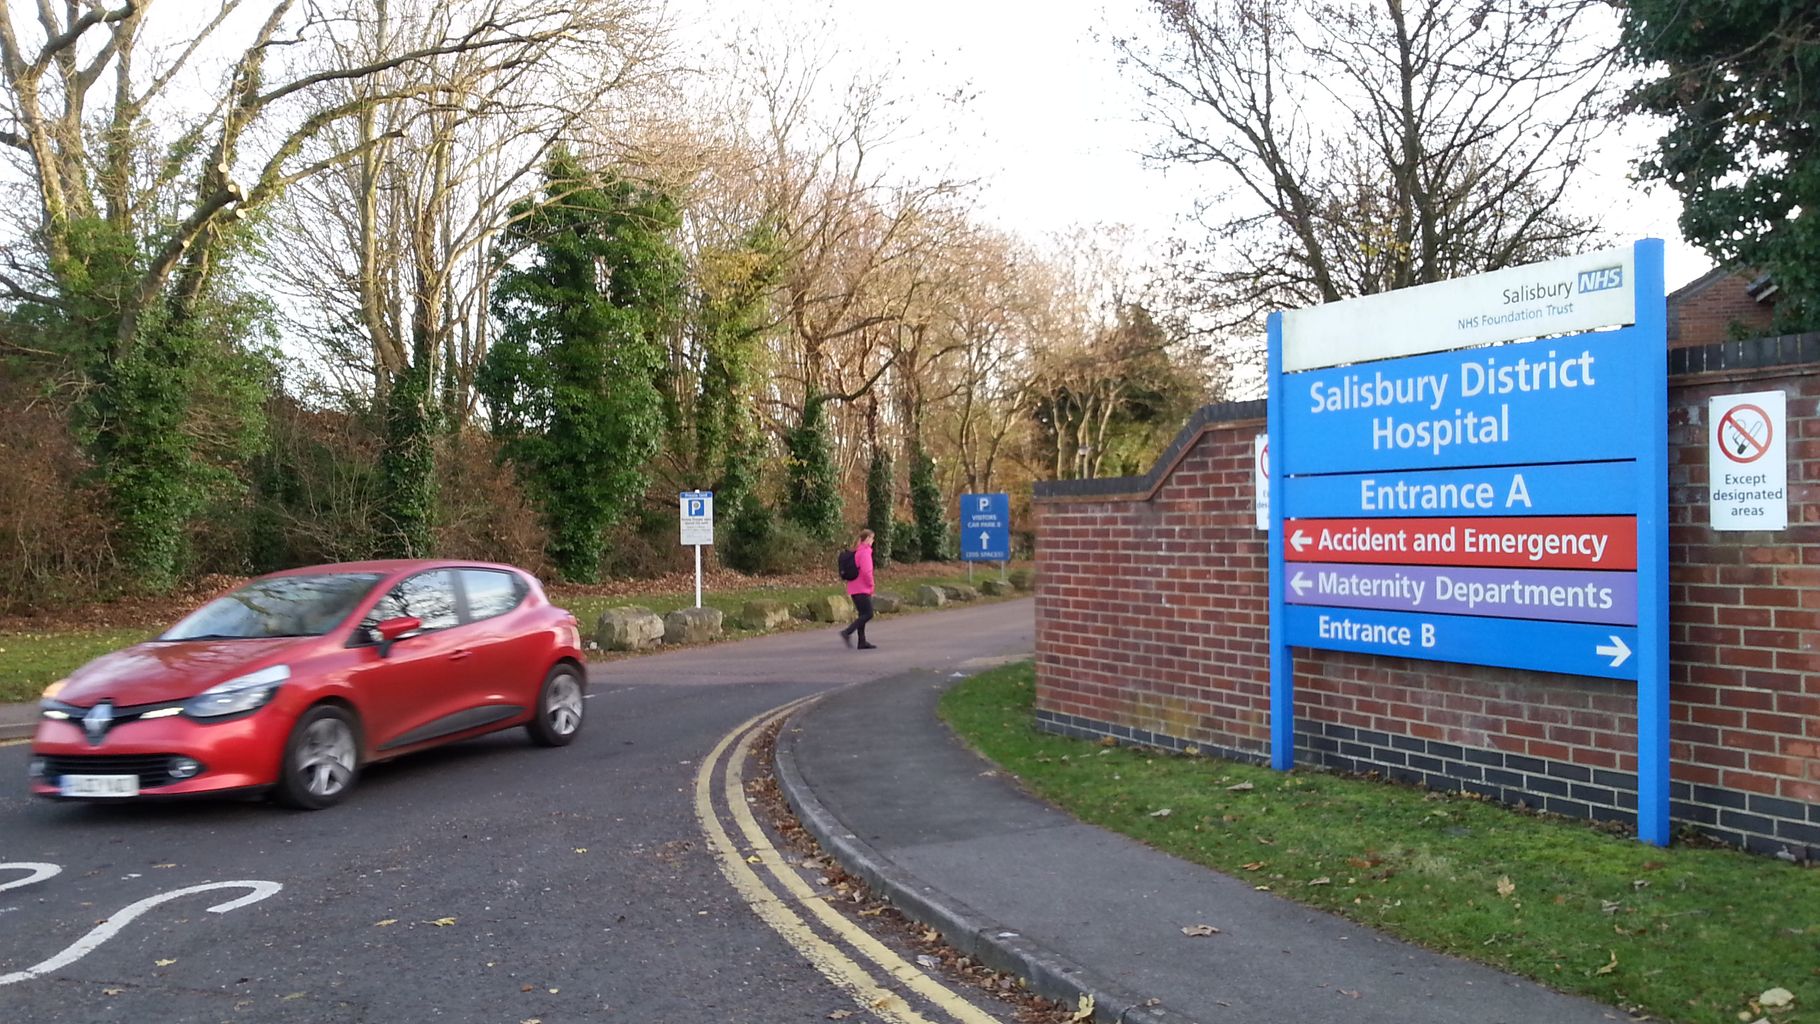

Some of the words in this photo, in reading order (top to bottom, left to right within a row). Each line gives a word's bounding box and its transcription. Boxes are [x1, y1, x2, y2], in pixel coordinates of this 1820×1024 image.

[1503, 281, 1573, 305] Salisbury
[1579, 267, 1622, 293] NHS
[1458, 317, 1479, 330] NHS
[1482, 308, 1543, 326] Foundation
[1547, 303, 1574, 316] Trust
[1310, 371, 1448, 414] Salisbury
[1460, 350, 1595, 398] District
[1372, 404, 1509, 456] Hospital
[1361, 479, 1494, 511] Entrance
[1505, 474, 1532, 508] A
[1713, 488, 1783, 503] designated
[1725, 474, 1767, 487] Except
[691, 500, 701, 516] P
[979, 497, 989, 512] P
[1731, 506, 1764, 516] areas
[1318, 526, 1407, 552] Accident
[1413, 526, 1456, 552] and
[1464, 528, 1608, 562] Emergency
[1318, 572, 1425, 605] Maternity
[1436, 575, 1613, 609] Departments
[1319, 615, 1411, 646] Entrance
[1421, 623, 1436, 648] B
